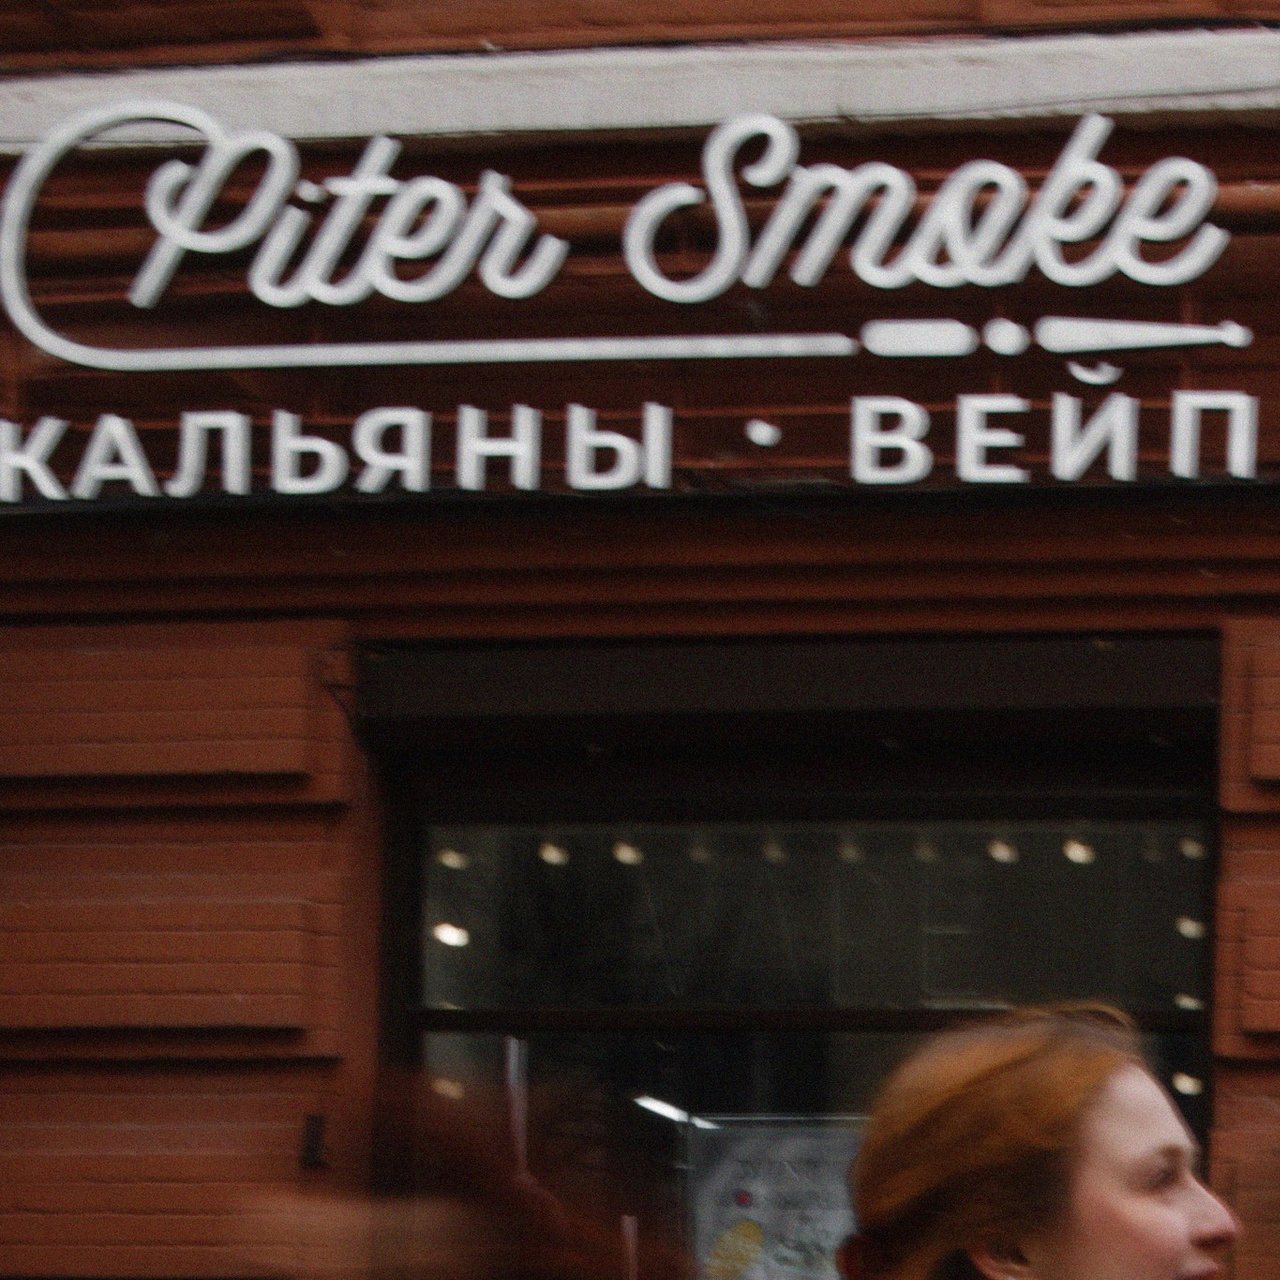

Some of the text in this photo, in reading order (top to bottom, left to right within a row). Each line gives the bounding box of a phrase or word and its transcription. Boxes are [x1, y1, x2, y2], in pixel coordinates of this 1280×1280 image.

[130, 111, 1232, 308] Piter Smoke
[0, 361, 1259, 501] КАЛЬЯНЫ ВЕЙП
